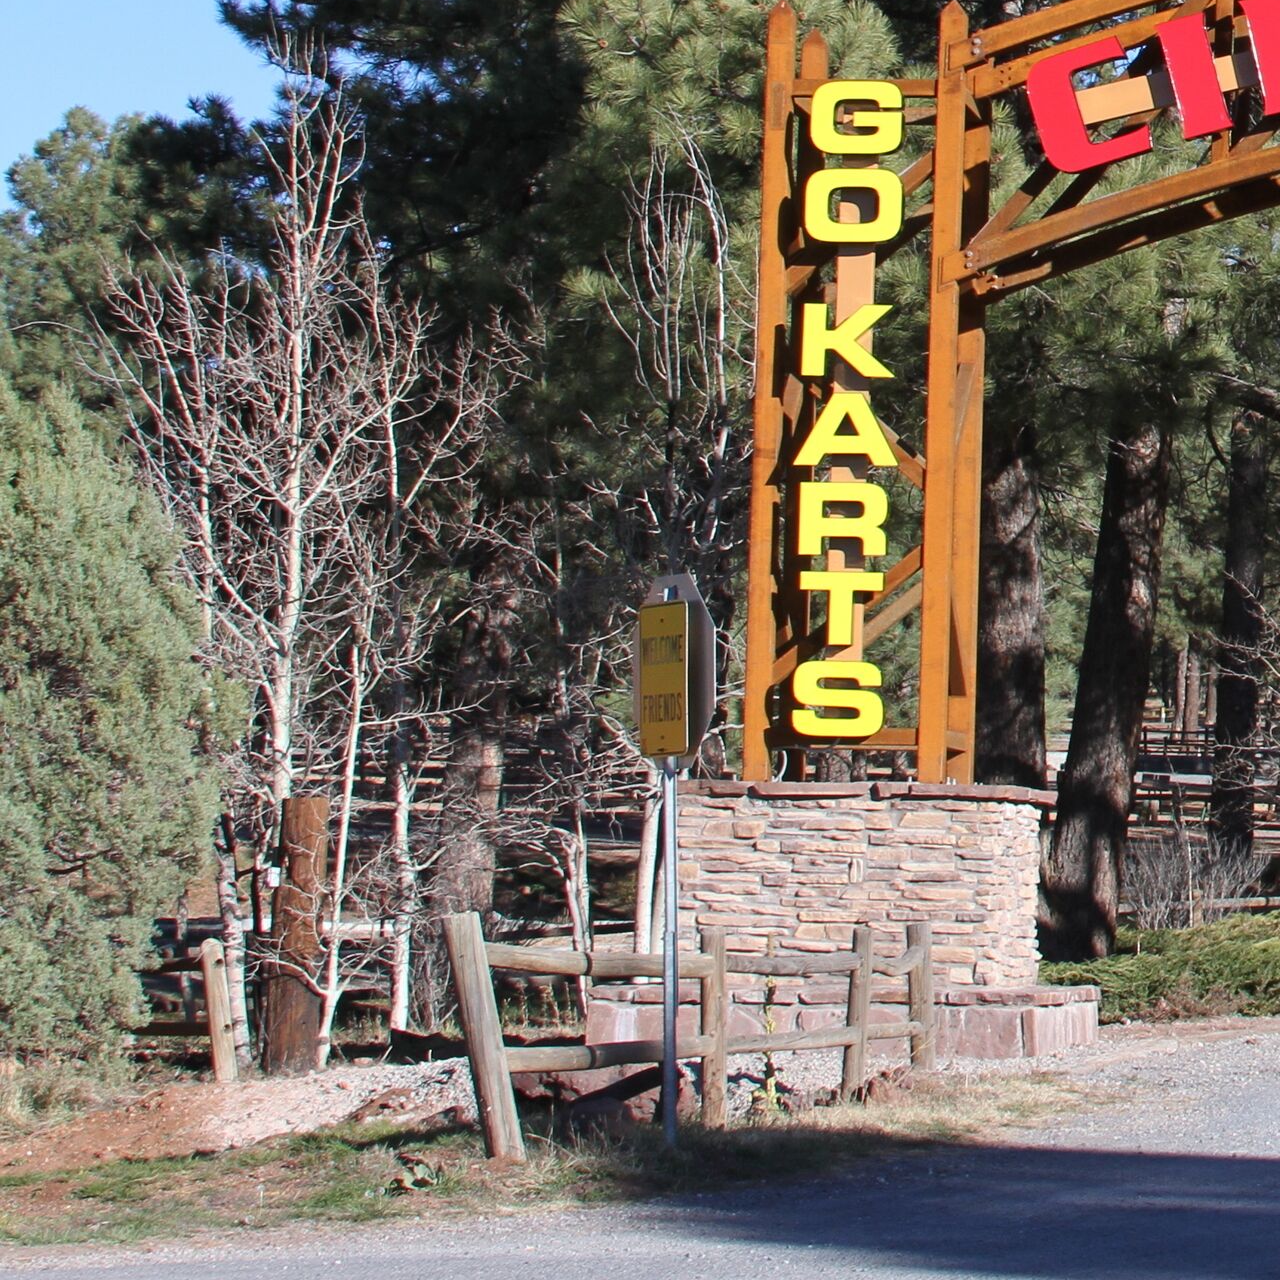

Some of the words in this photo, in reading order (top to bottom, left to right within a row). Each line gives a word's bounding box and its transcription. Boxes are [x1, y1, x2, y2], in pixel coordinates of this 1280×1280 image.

[791, 303, 898, 738] KARTS
[641, 634, 683, 666] WELCOME
[642, 693, 682, 723] FRIENDS
